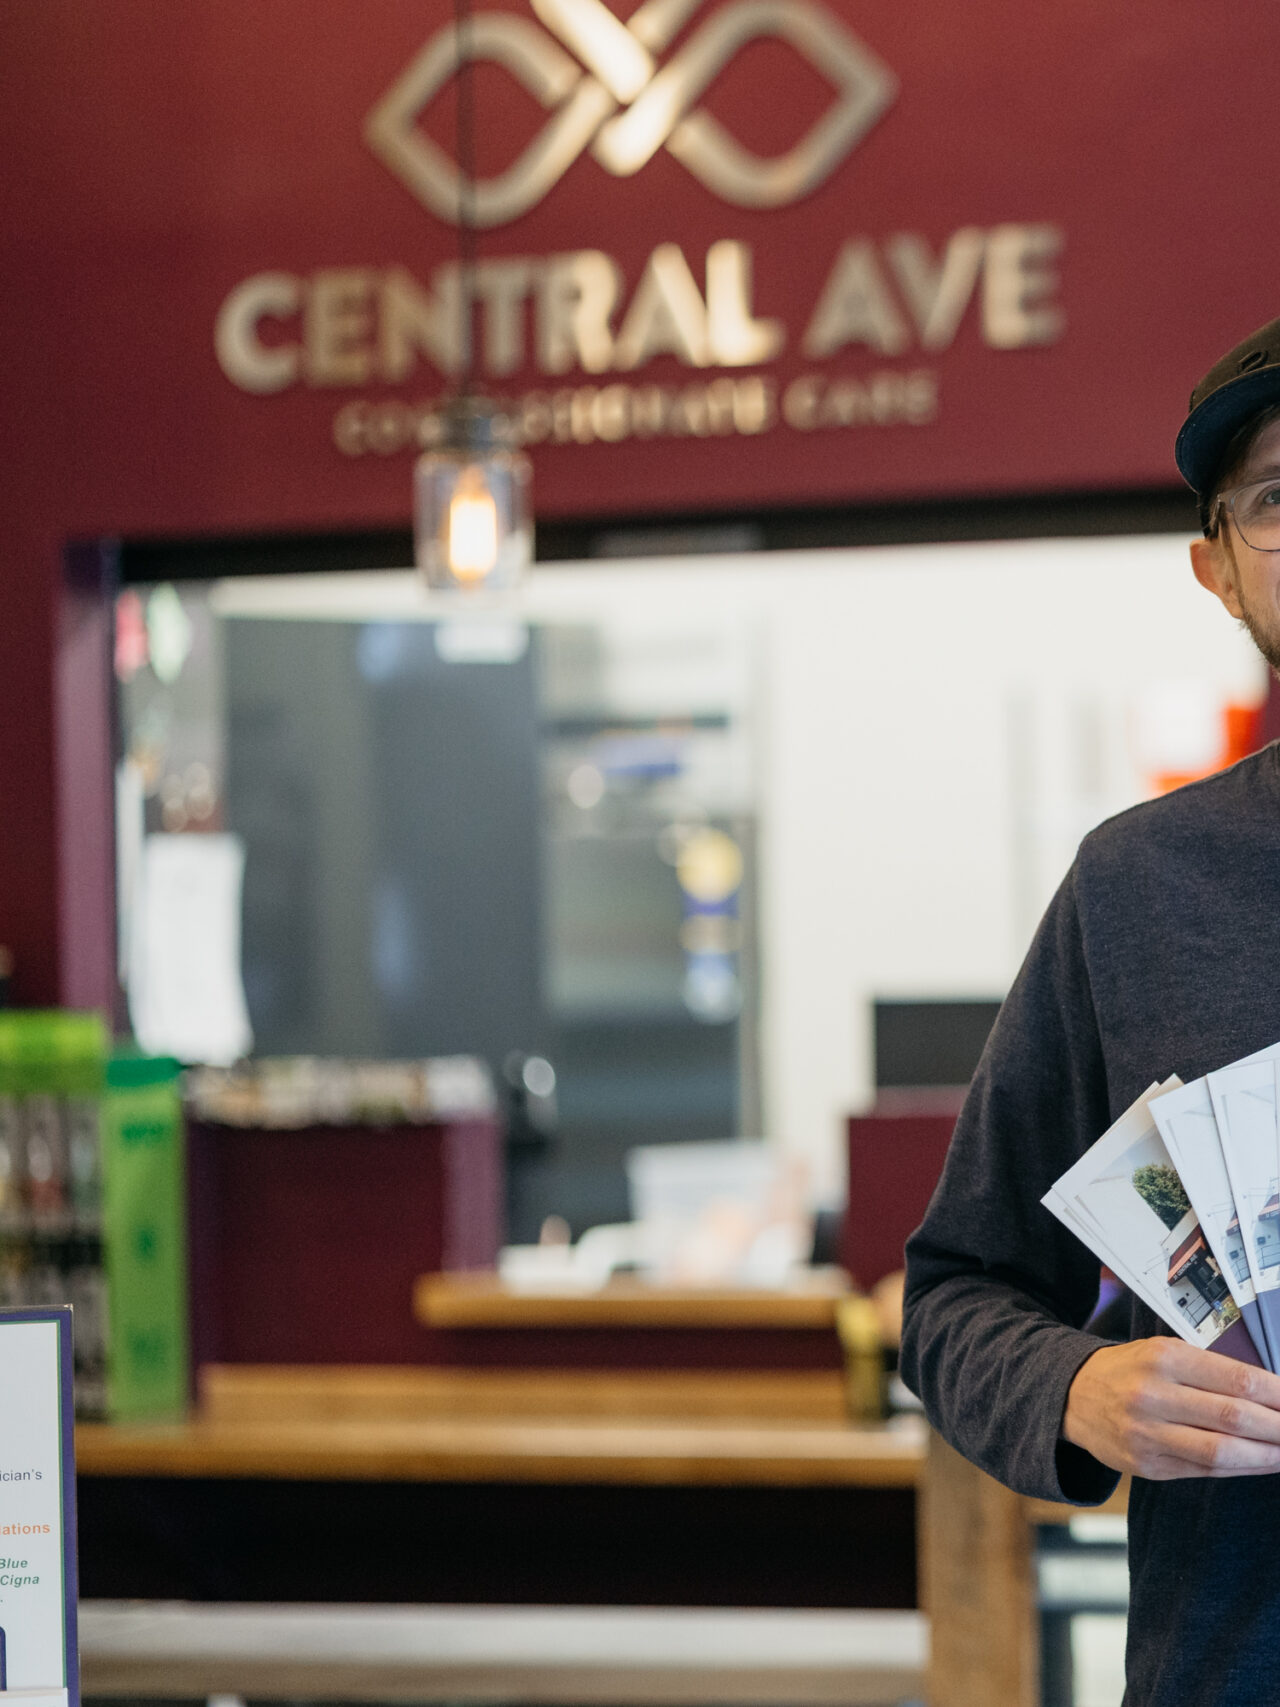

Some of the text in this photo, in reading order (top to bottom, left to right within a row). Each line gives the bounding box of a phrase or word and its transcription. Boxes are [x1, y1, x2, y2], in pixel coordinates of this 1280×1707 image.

[216, 226, 1064, 392] CENTRAL AVE
[0, 1523, 50, 1535] ations
[0, 1558, 28, 1569] Blue
[0, 1574, 40, 1588] Cigna
